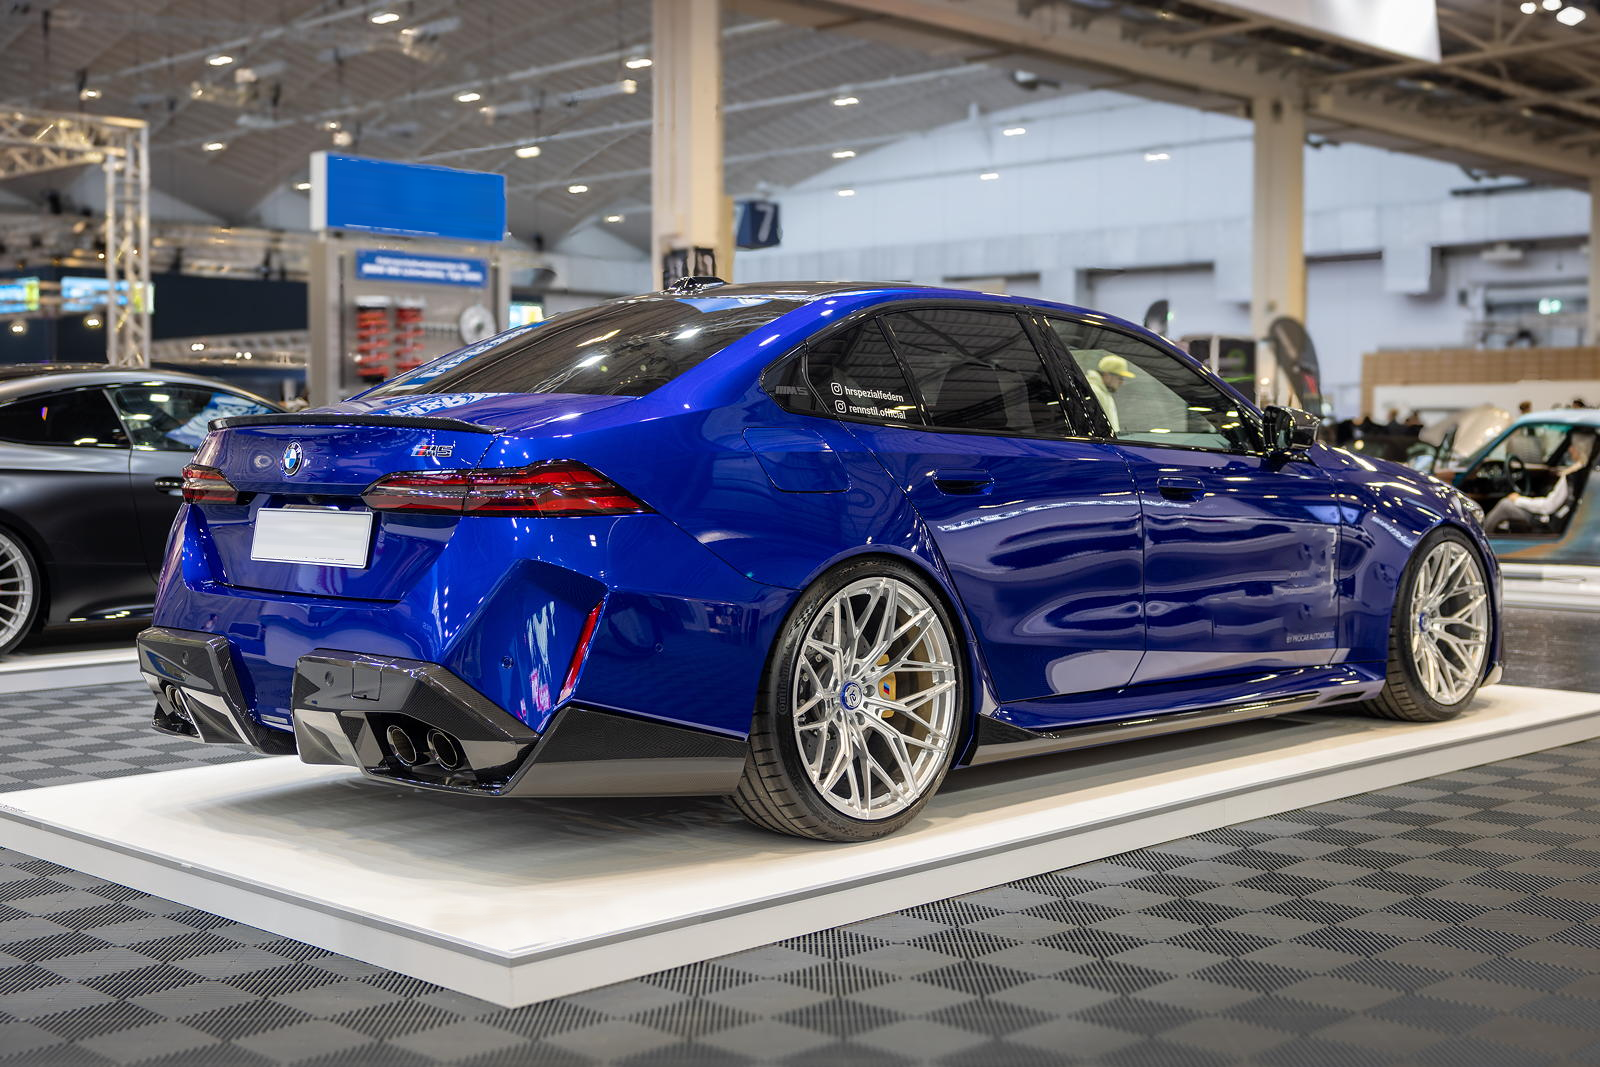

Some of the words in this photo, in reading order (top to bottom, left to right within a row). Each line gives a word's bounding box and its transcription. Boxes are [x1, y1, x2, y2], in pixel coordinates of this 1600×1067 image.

[756, 204, 774, 242] 7
[844, 386, 904, 402] hrspezialfedern
[849, 405, 906, 420] rennstil.official
